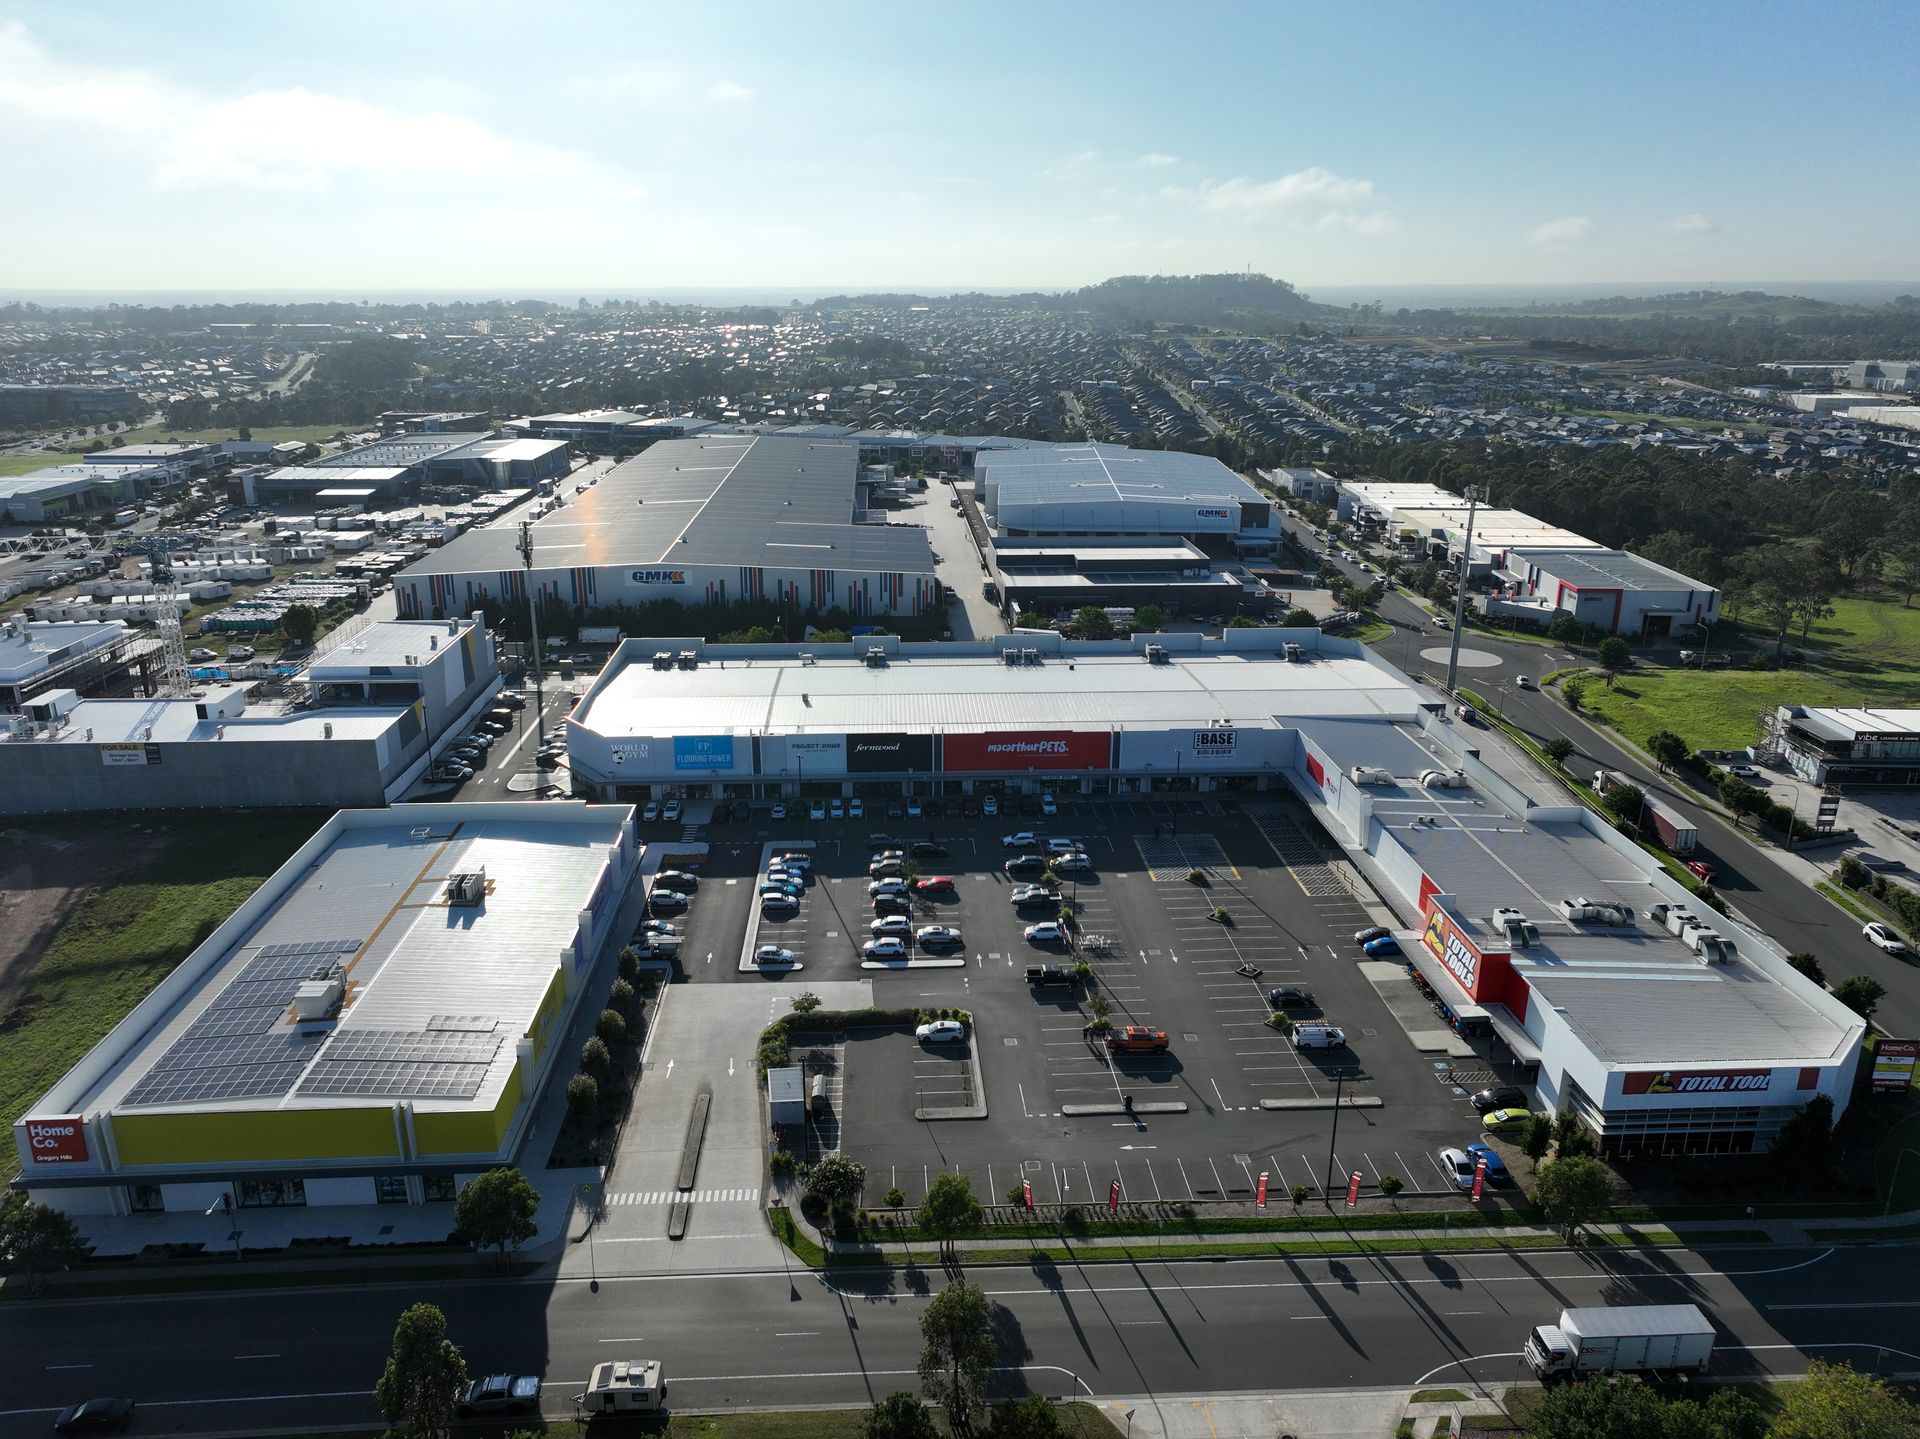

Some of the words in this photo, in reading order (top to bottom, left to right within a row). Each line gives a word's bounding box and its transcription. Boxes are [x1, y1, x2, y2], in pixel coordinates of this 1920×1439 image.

[632, 571, 673, 582] GMK
[1201, 733, 1233, 744] BASE
[1857, 733, 1878, 741] vibe
[611, 743, 648, 752] WORLD
[854, 743, 900, 752] fernwood
[625, 751, 648, 759] GYM
[677, 755, 707, 763] FLOORING
[708, 754, 731, 763] POWER
[1447, 931, 1477, 973] TOTAL
[1444, 947, 1475, 989] TOOLS
[1677, 1076, 1728, 1091] TOTAL
[30, 1125, 74, 1136] Home
[33, 1136, 59, 1148] Co.
